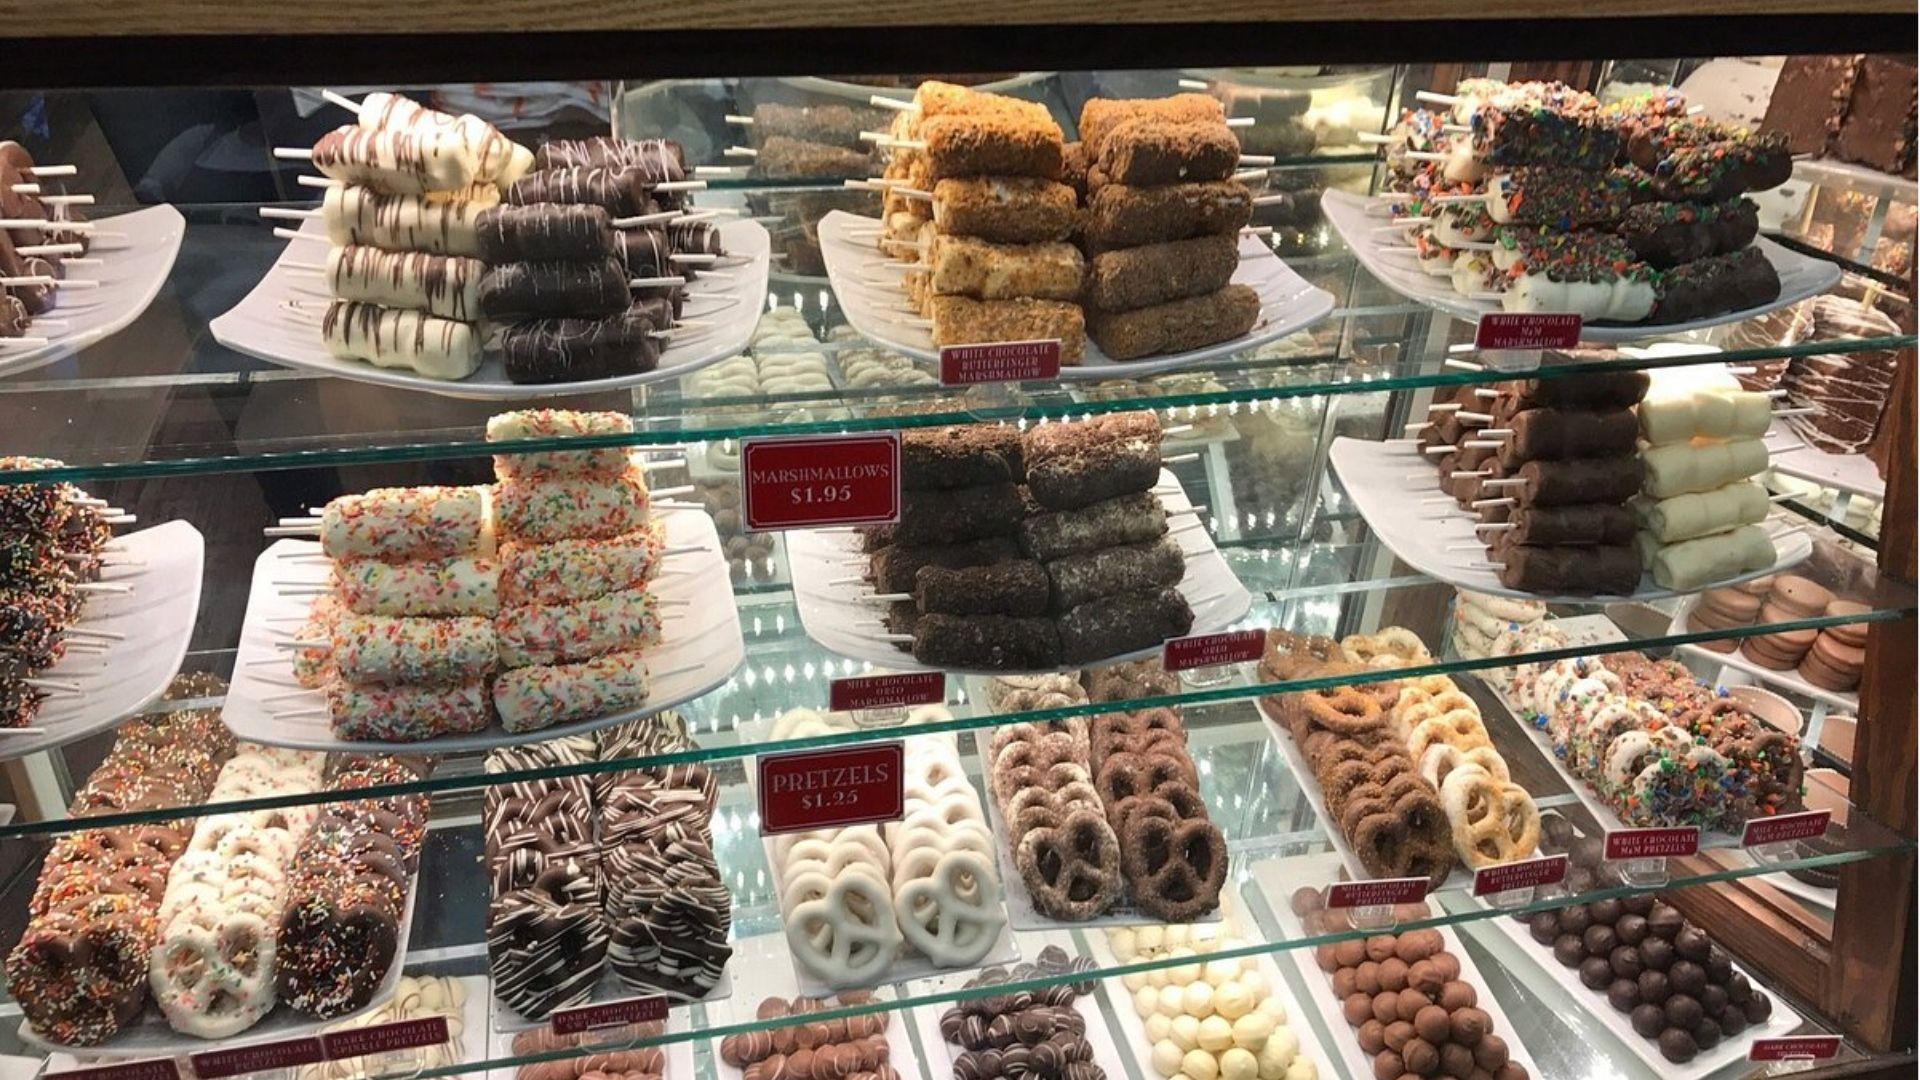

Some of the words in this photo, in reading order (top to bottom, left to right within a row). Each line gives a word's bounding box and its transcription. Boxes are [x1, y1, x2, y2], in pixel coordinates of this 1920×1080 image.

[987, 344, 1049, 358] CHOCOLATE
[752, 463, 890, 484] MARSHMALLOWS
[790, 485, 852, 504] $1.95
[875, 675, 932, 687] CHOCOLATE
[772, 763, 889, 793] PRETZELS
[801, 789, 859, 810] $1.25
[1643, 834, 1696, 843] CHOCOLATE
[1643, 843, 1686, 853] PRETZELS
[370, 1023, 437, 1040] CHOCOLATE
